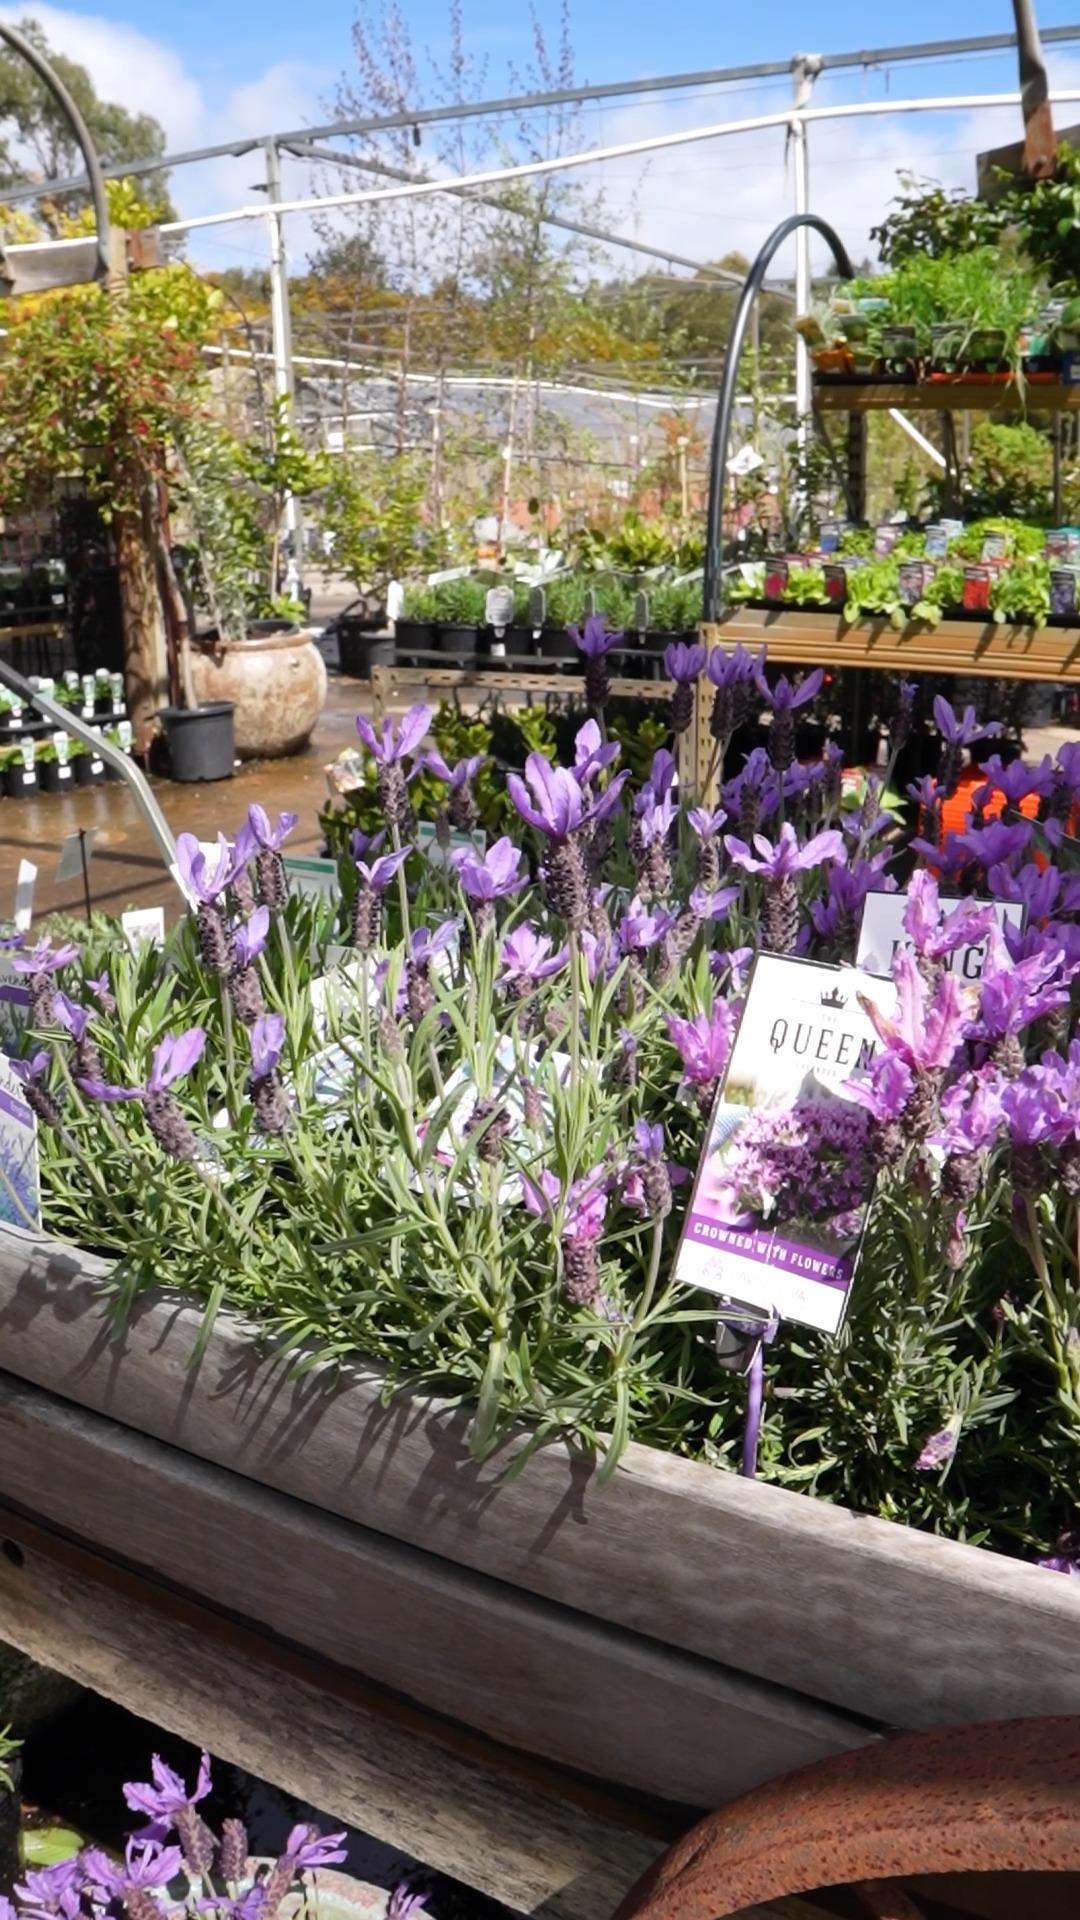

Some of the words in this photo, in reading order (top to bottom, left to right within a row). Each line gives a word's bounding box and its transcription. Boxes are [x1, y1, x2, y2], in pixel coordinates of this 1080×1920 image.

[769, 1018, 877, 1070] QUEEN
[693, 1222, 752, 1250] CROWNED
[790, 1252, 844, 1280] FLOWERS
